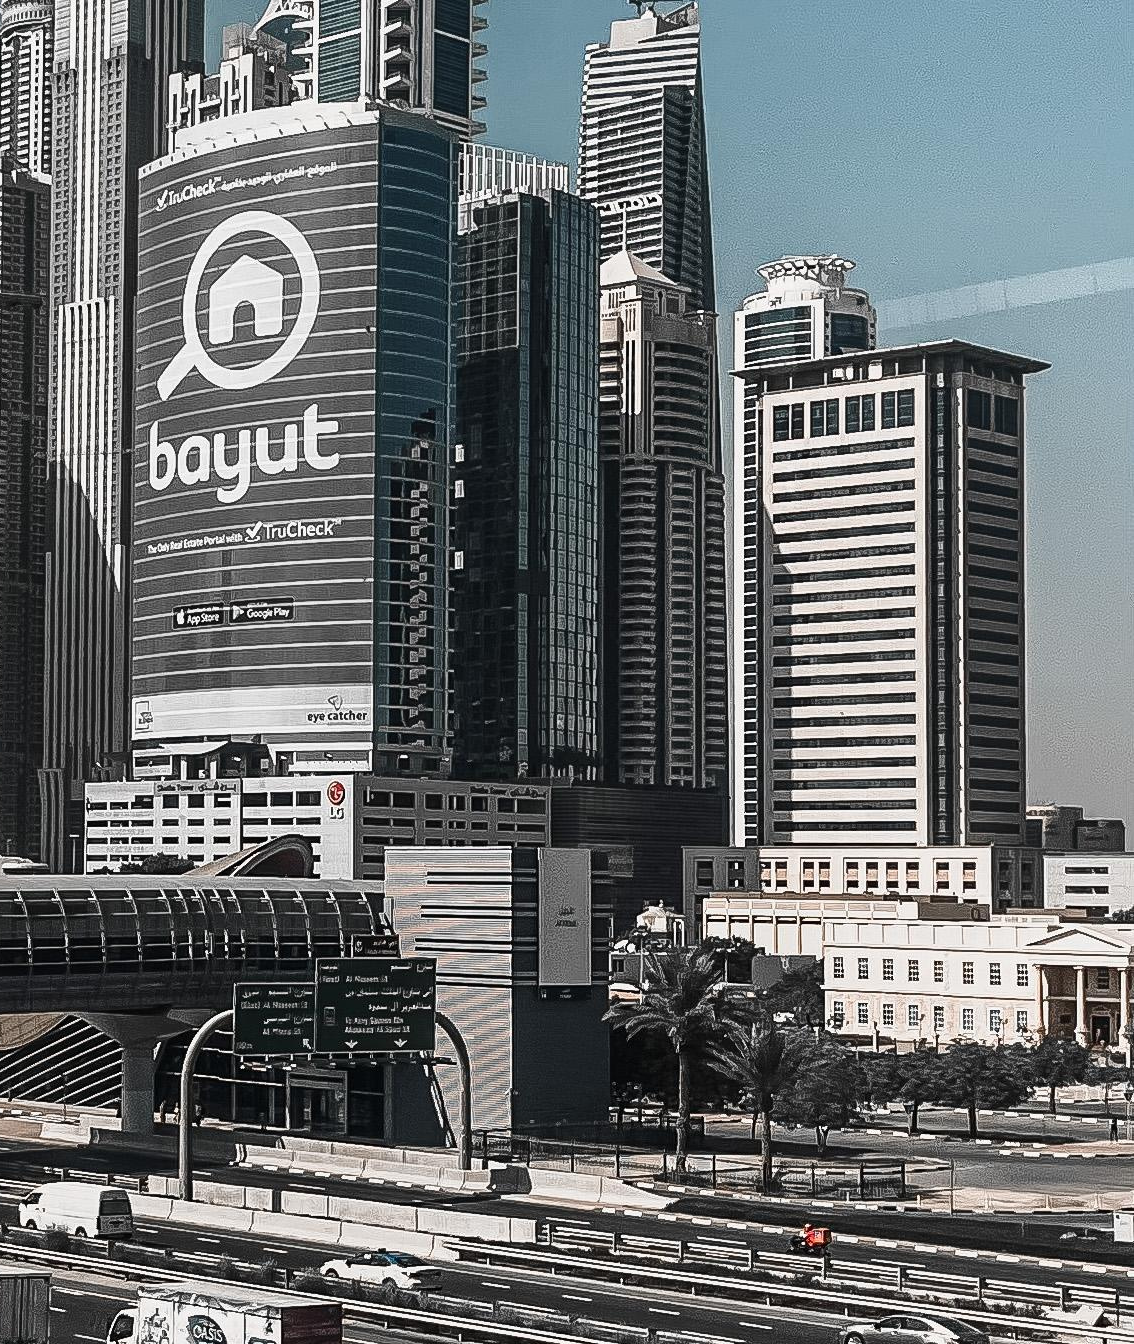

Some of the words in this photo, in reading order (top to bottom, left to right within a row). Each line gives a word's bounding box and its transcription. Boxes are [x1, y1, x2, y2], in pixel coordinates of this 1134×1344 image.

[148, 403, 340, 504] bayut
[183, 538, 203, 549] Estate
[204, 534, 225, 546] Portal
[187, 615, 201, 626] App
[201, 612, 220, 623] Store
[246, 608, 273, 620] Google
[274, 606, 290, 618] Play
[307, 712, 325, 723] eye
[327, 709, 368, 722] catcher
[329, 806, 345, 820] LG
[192, 1324, 224, 1343] OASIS
